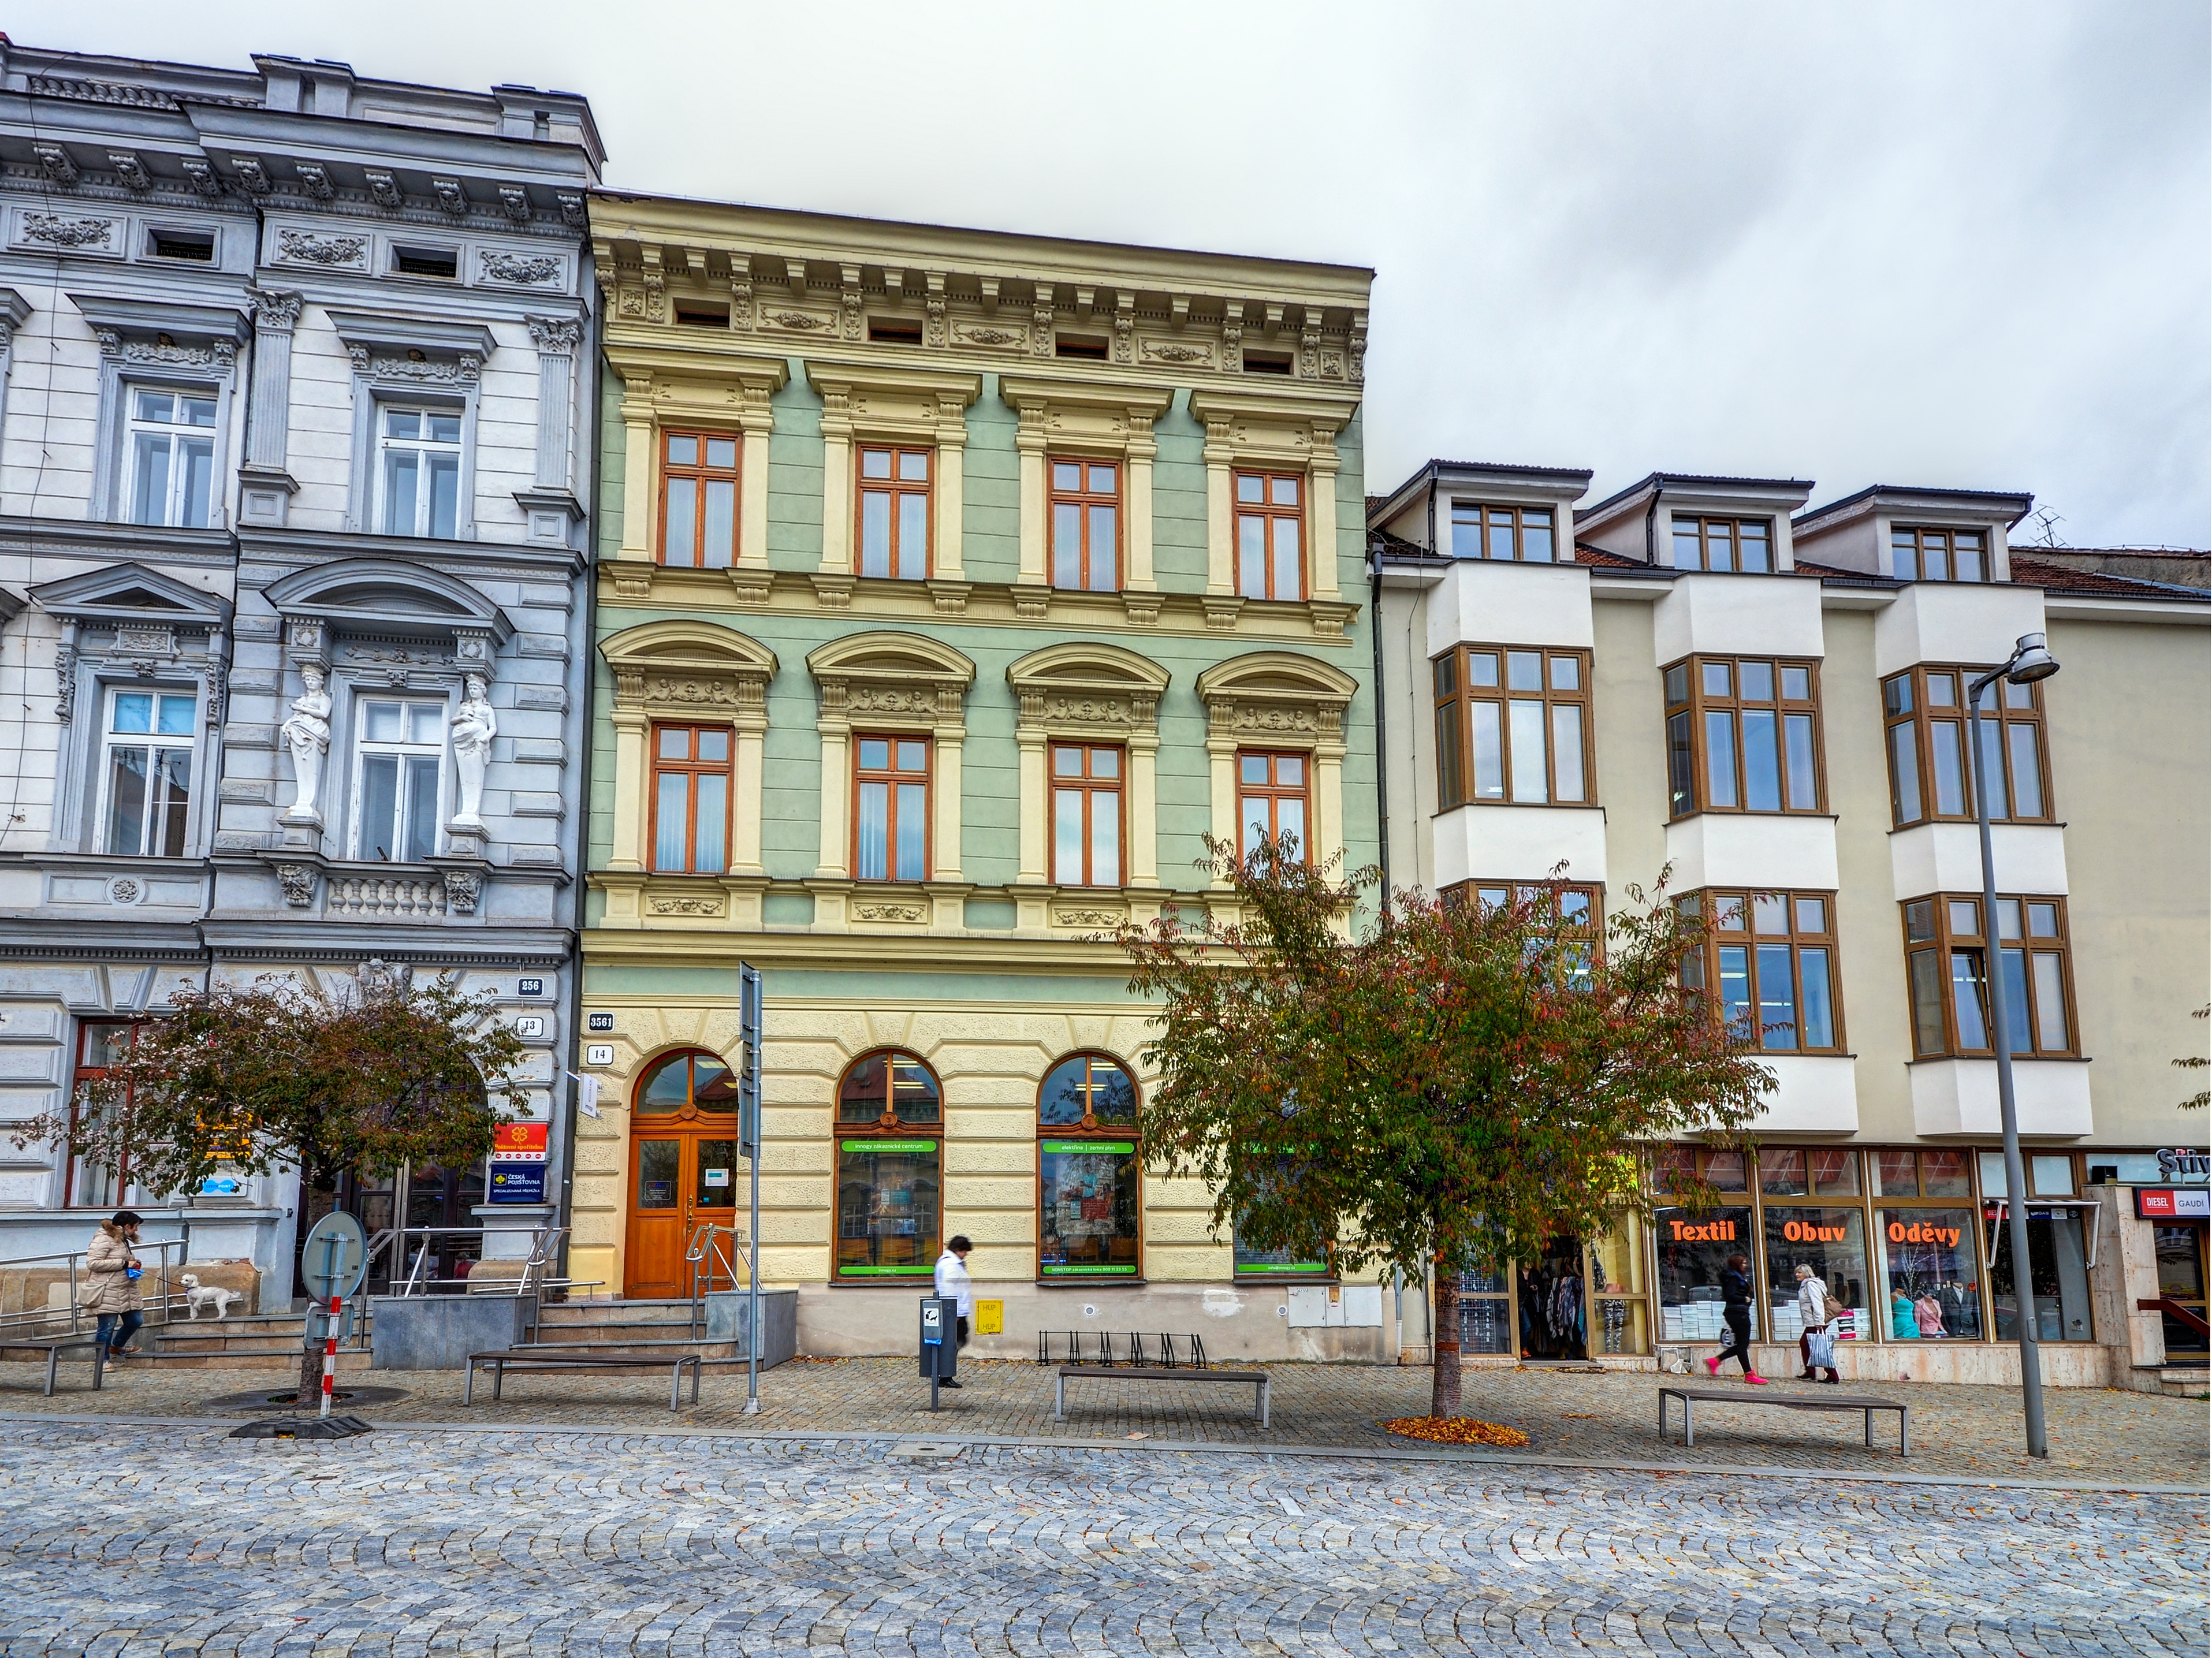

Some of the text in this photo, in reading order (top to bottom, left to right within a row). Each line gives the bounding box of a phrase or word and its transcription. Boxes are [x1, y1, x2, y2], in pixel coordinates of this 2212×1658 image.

[522, 981, 539, 990] 256
[525, 1020, 535, 1030] 13
[590, 1017, 612, 1027] 3561
[594, 1049, 605, 1059] 14
[2146, 1197, 2169, 1206] DIESEL
[1670, 1221, 1735, 1241] Textil
[1783, 1221, 1846, 1242] Obuv
[1889, 1221, 1961, 1247] Oděvy
